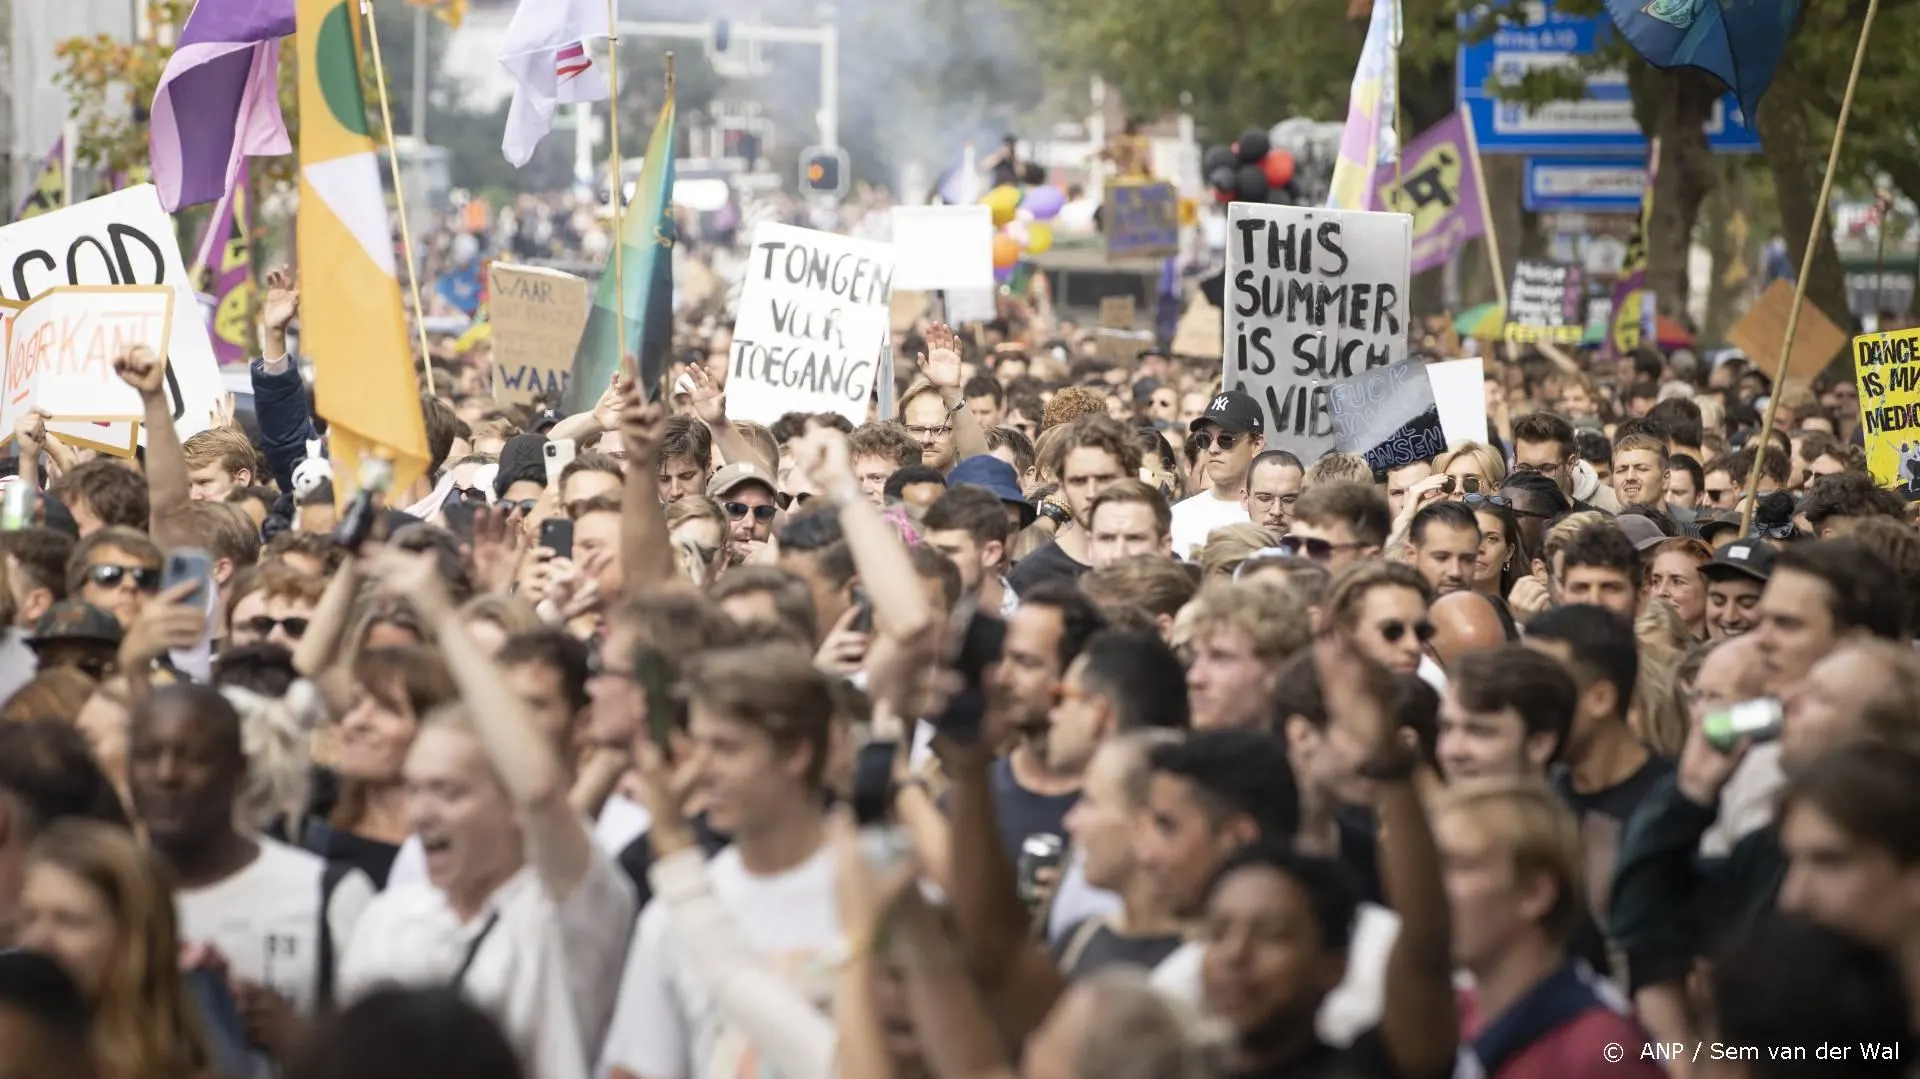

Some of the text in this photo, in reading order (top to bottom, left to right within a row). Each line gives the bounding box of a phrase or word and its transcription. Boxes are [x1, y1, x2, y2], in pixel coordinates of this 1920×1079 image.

[493, 274, 555, 304] WAAR
[758, 242, 895, 305] TONGEN
[1235, 270, 1400, 335] SUMMER
[732, 339, 871, 402] TOEGANG
[1293, 334, 1389, 379] SUCH
[1859, 337, 1920, 367] DANCE
[1330, 365, 1408, 414] FUCK
[1862, 371, 1885, 398] IS
[1265, 384, 1334, 438] VIB
[1366, 426, 1444, 468] ANSEN
